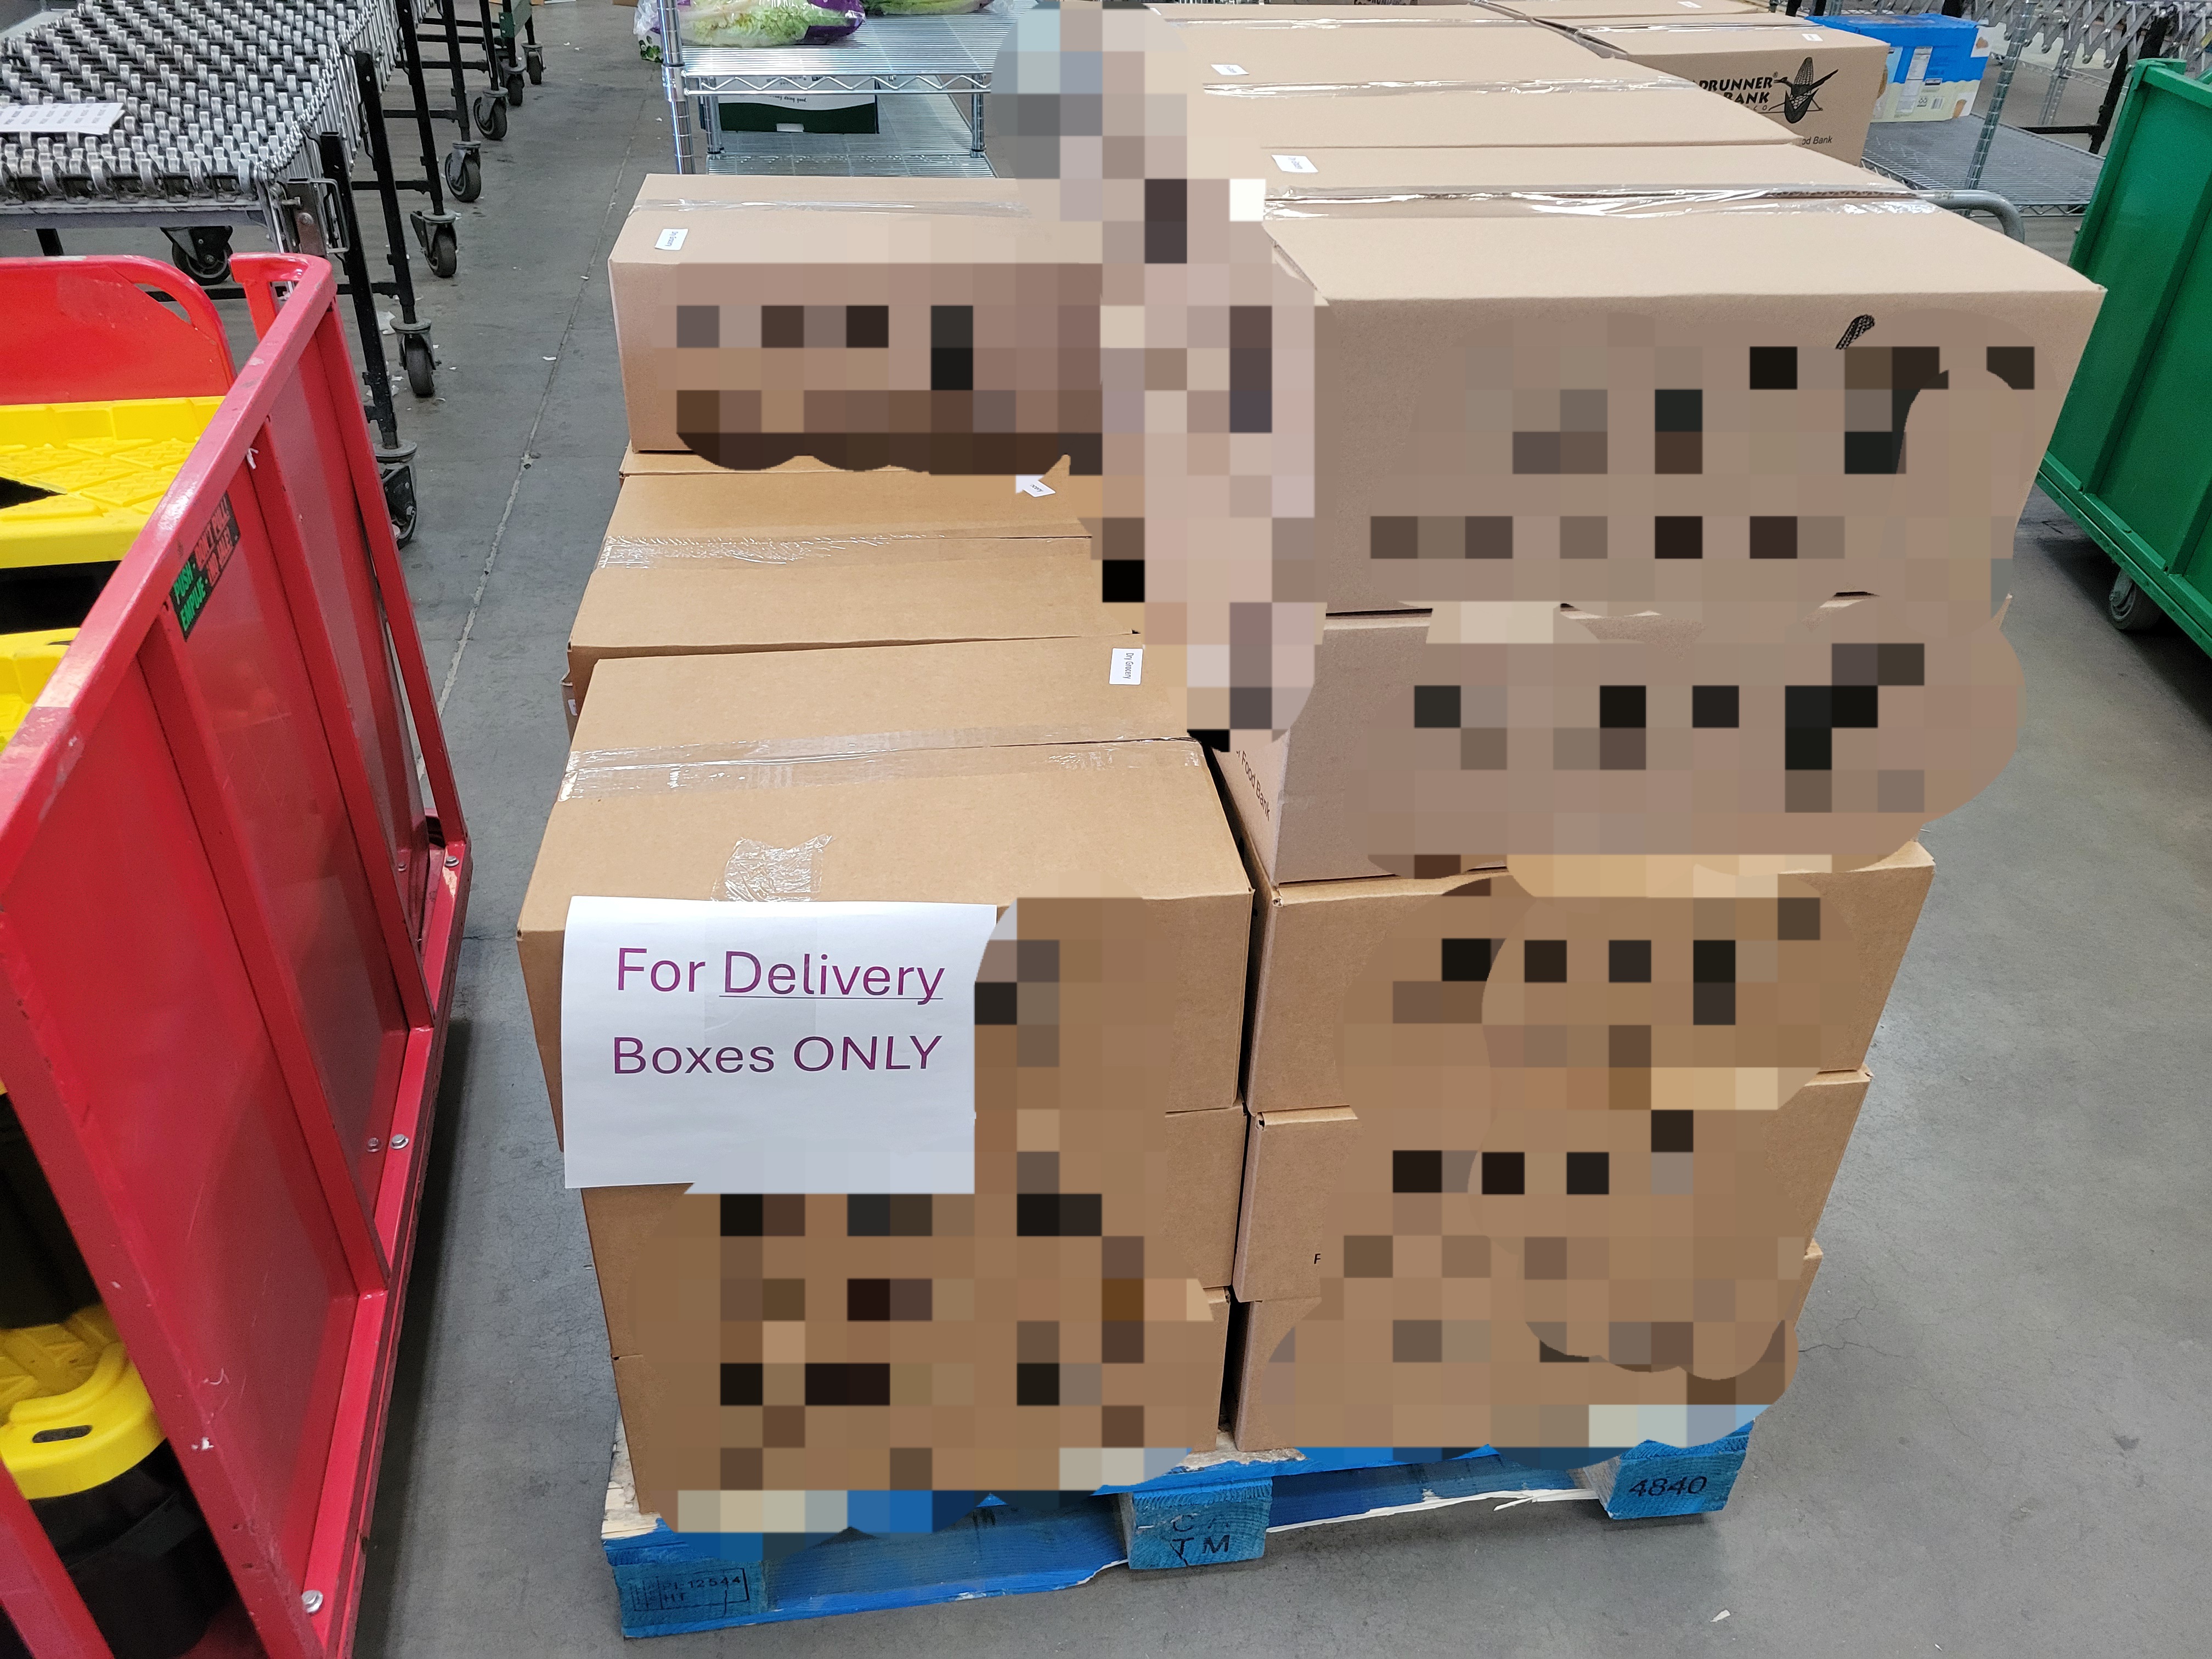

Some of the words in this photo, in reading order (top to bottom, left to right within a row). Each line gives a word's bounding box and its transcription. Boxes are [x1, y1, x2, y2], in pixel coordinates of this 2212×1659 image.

[1693, 77, 1773, 91] DRUNNER
[1813, 136, 1832, 144] Bank
[173, 560, 194, 605] PUSH
[180, 575, 206, 631] EMPUJE
[1122, 661, 1134, 679] Grocery
[1242, 751, 1256, 789] Food
[1256, 779, 1271, 821] Bank
[618, 947, 706, 992] For
[724, 951, 945, 1005] Delivery
[614, 1037, 774, 1074] Boxes
[794, 1035, 943, 1072] ONLY
[1628, 1476, 1707, 1497] 4840
